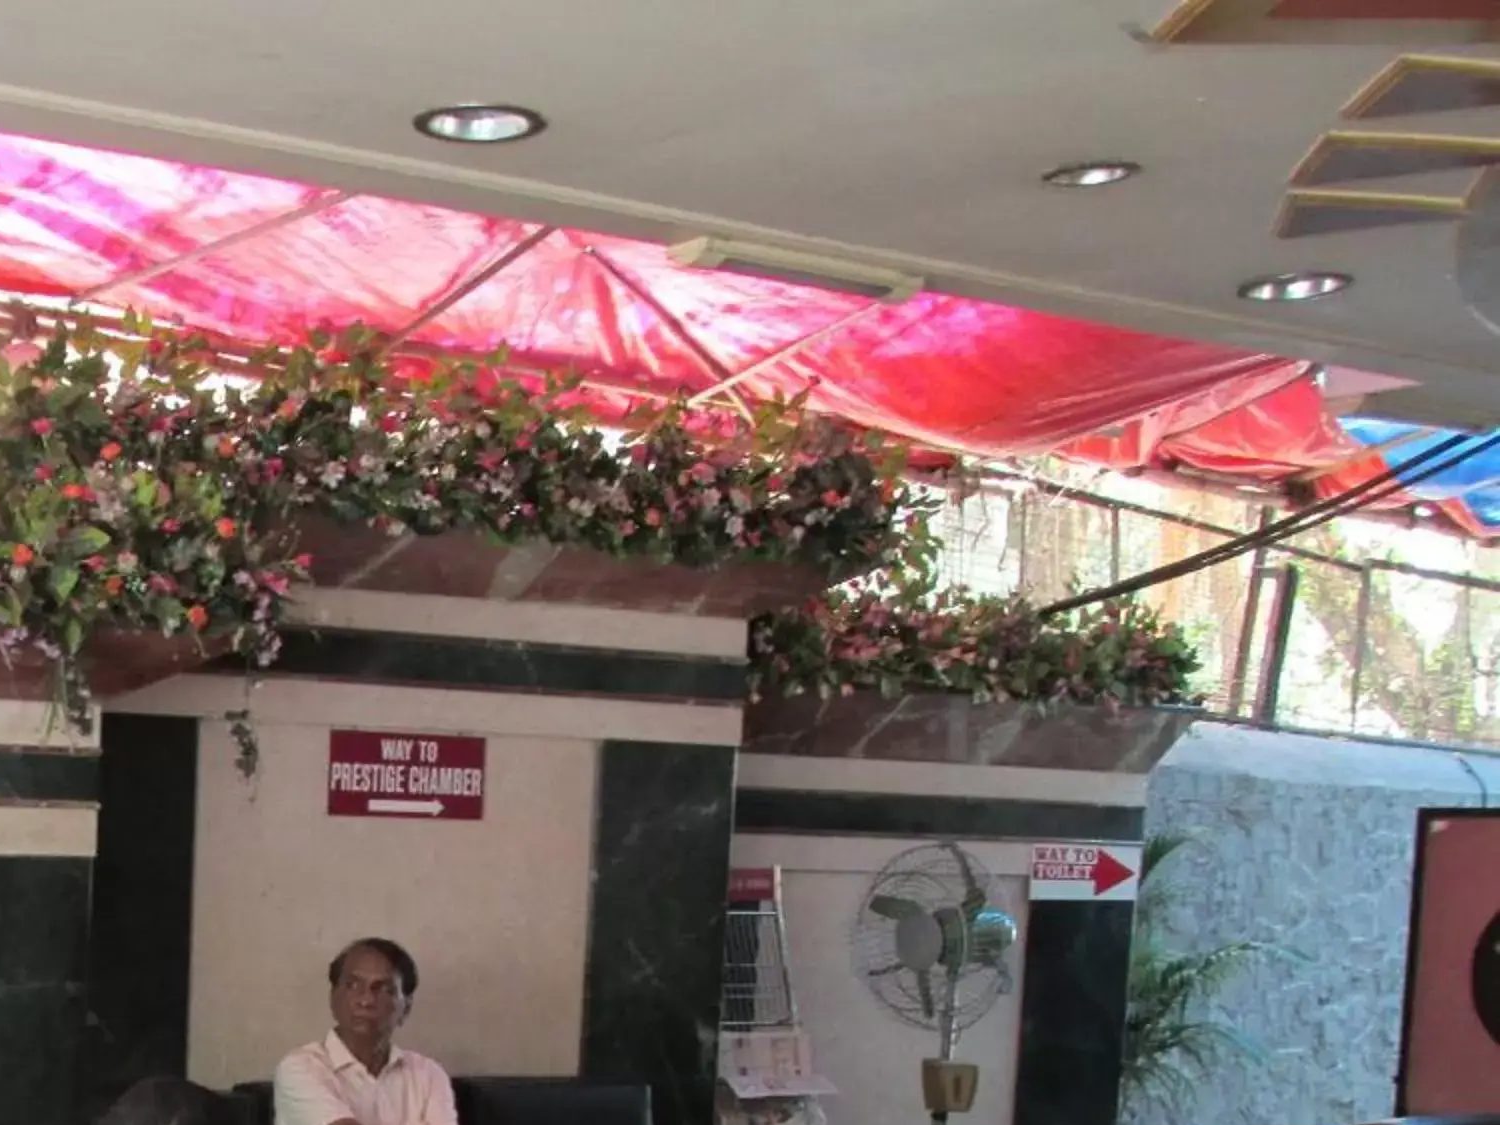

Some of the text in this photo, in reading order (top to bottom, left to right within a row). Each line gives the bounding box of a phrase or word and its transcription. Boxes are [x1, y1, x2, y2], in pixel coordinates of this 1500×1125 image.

[381, 738, 439, 762] WAY TO
[330, 763, 482, 796] PRESTIGE CHAMBER
[1035, 847, 1094, 862] WAY TO
[1035, 864, 1093, 879] TOILET
